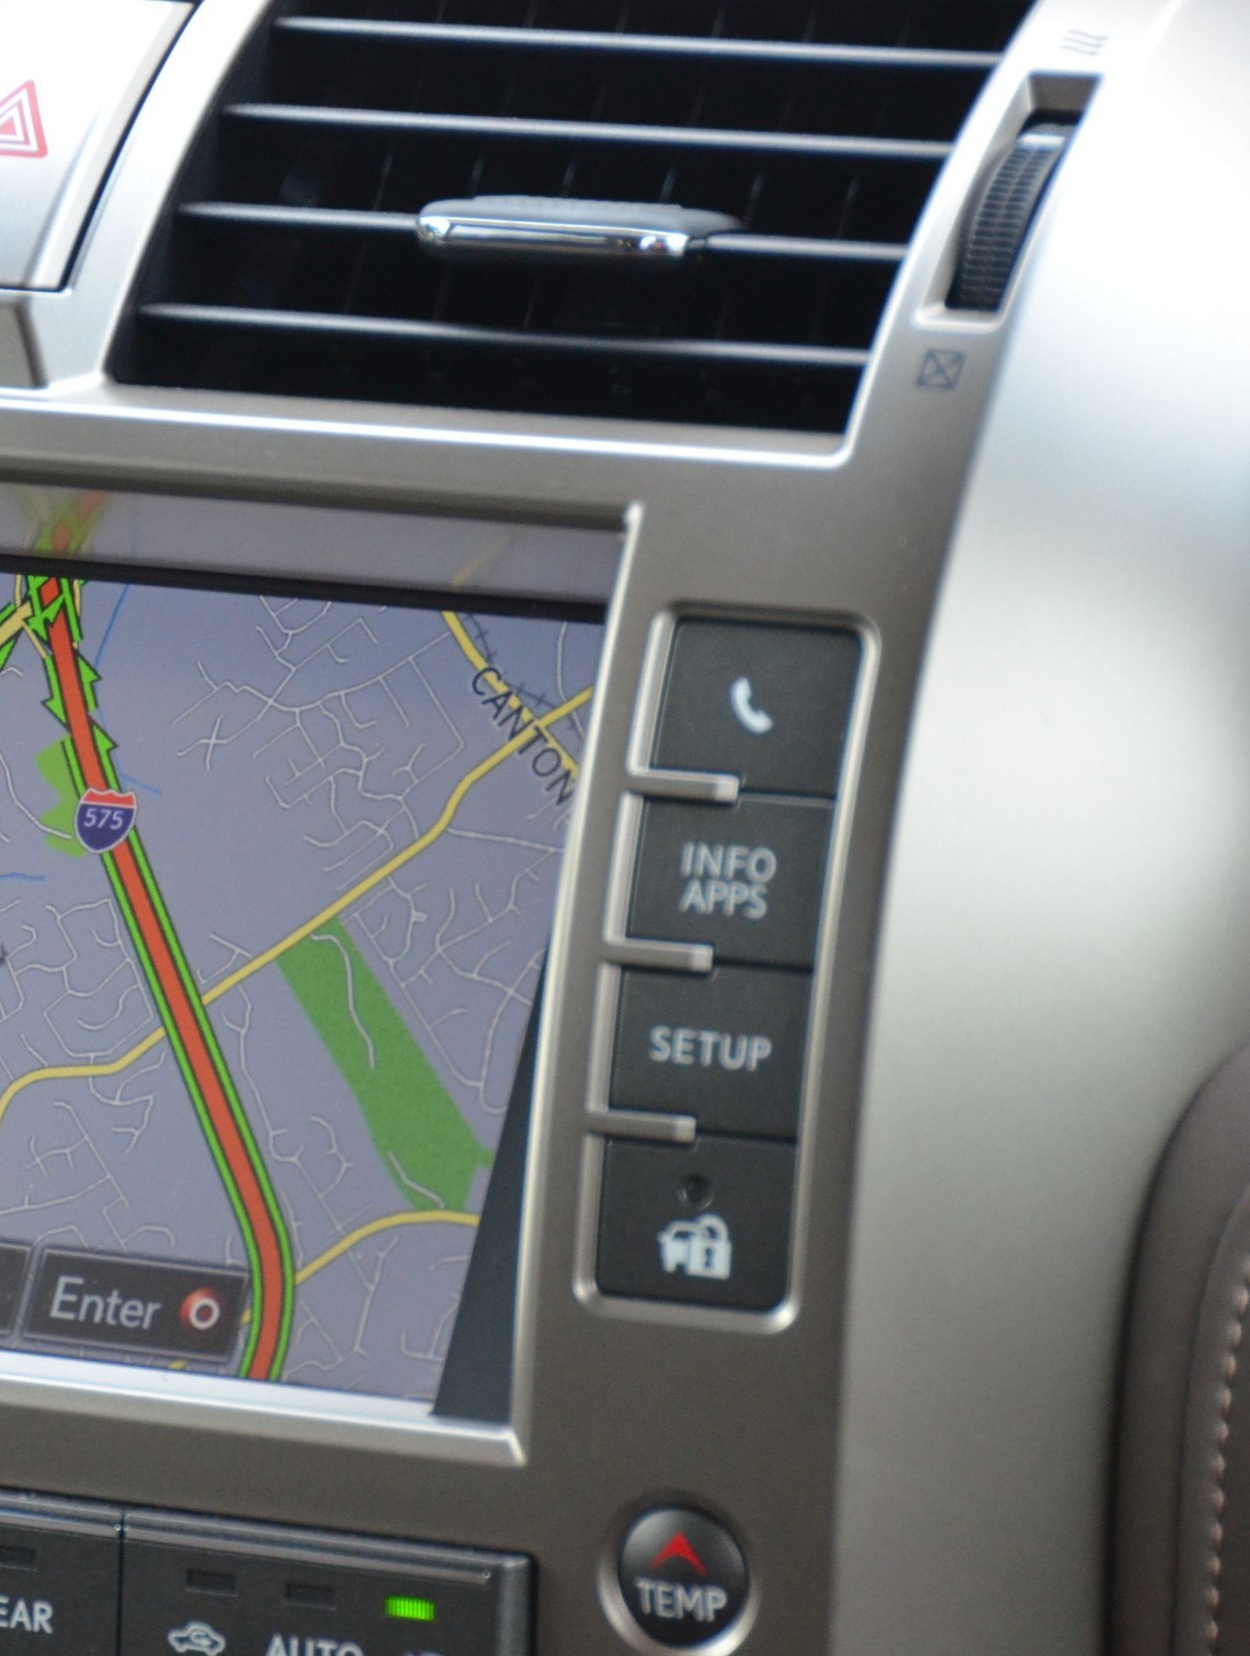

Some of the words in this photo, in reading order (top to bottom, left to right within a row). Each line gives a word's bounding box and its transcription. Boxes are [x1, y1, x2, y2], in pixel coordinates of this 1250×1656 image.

[472, 667, 574, 806] CANTON
[83, 807, 123, 830] 575
[680, 842, 776, 882] INFO
[680, 884, 767, 920] APPS
[650, 1026, 772, 1071] SETUP
[50, 1276, 161, 1330] Enter
[636, 1578, 727, 1622] TEMP
